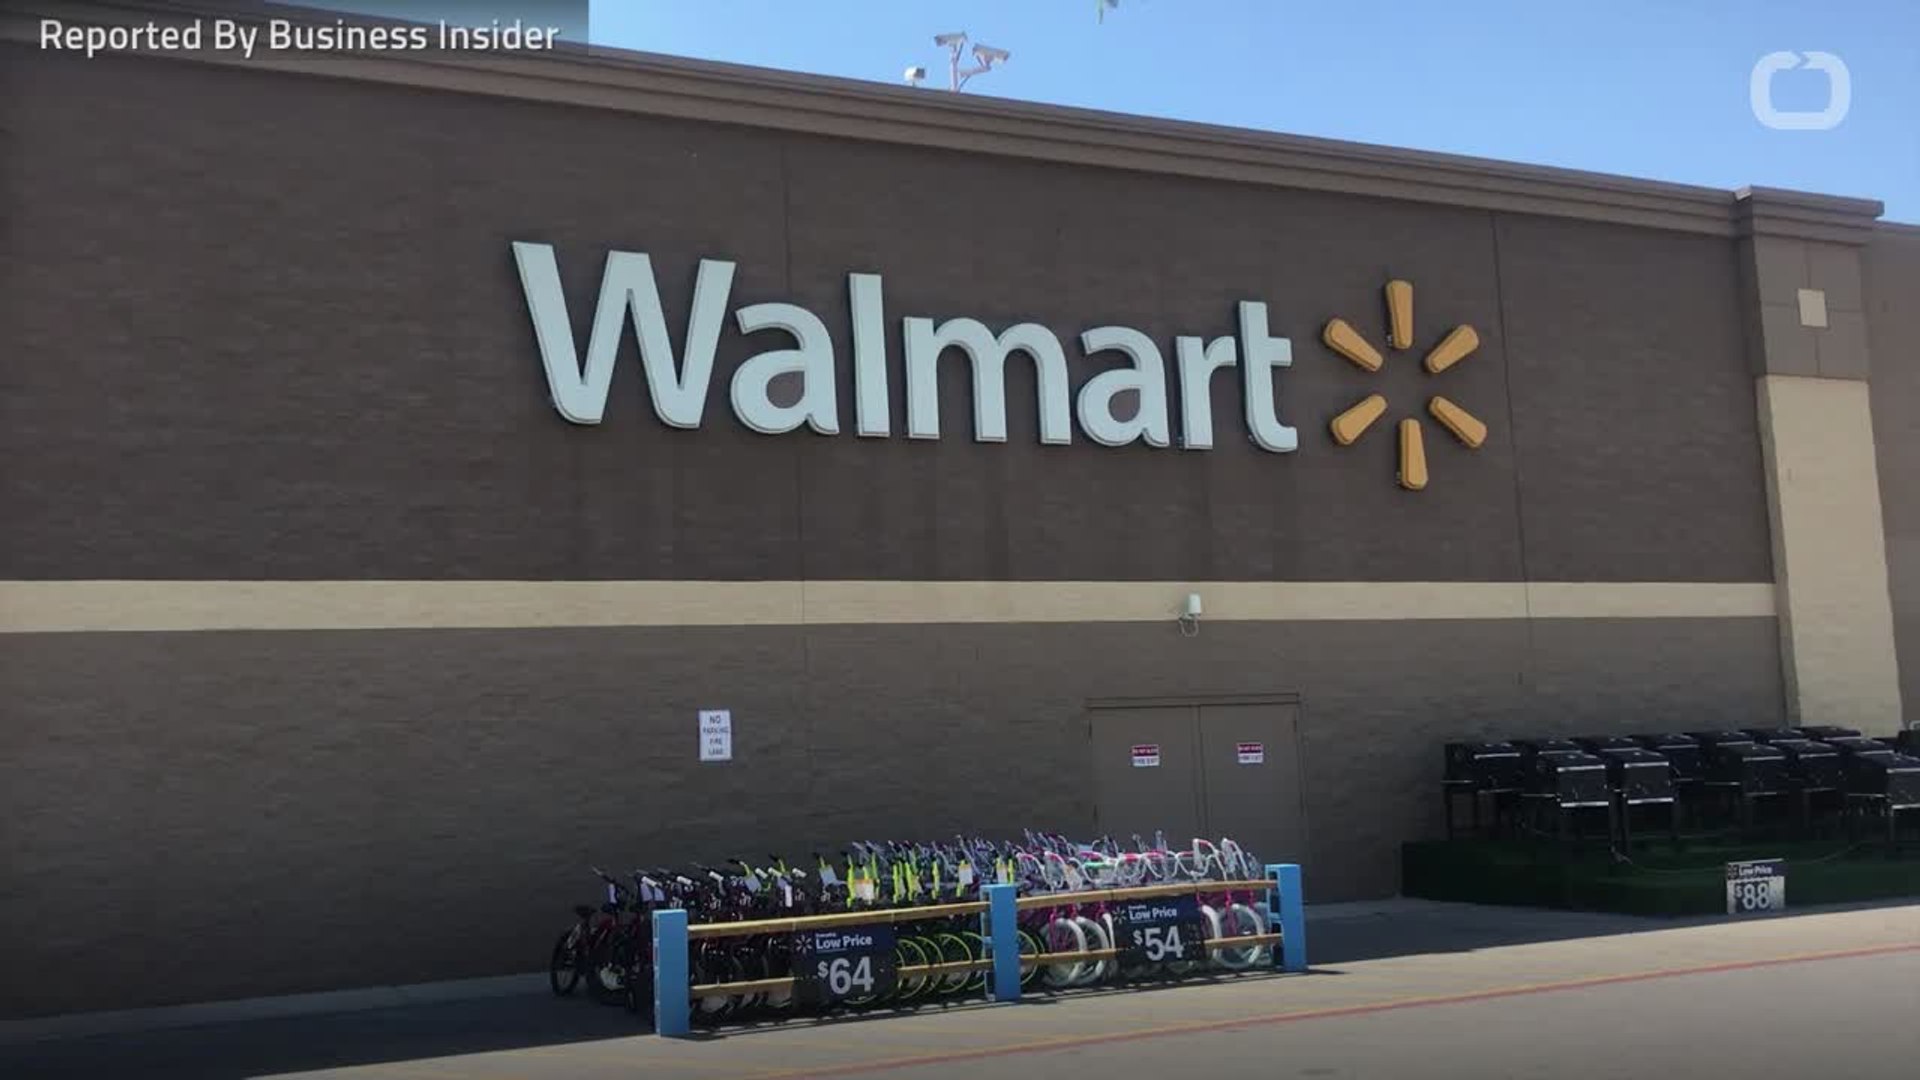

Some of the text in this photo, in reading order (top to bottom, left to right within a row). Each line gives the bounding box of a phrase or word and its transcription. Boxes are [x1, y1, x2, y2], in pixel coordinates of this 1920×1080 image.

[512, 240, 1299, 454] Walmart
[709, 715, 721, 724] NO
[1129, 906, 1177, 920] Low Price
[816, 937, 842, 950] Low
[842, 934, 873, 947] Price
[1132, 925, 1184, 961] $54
[817, 956, 874, 995] $64
